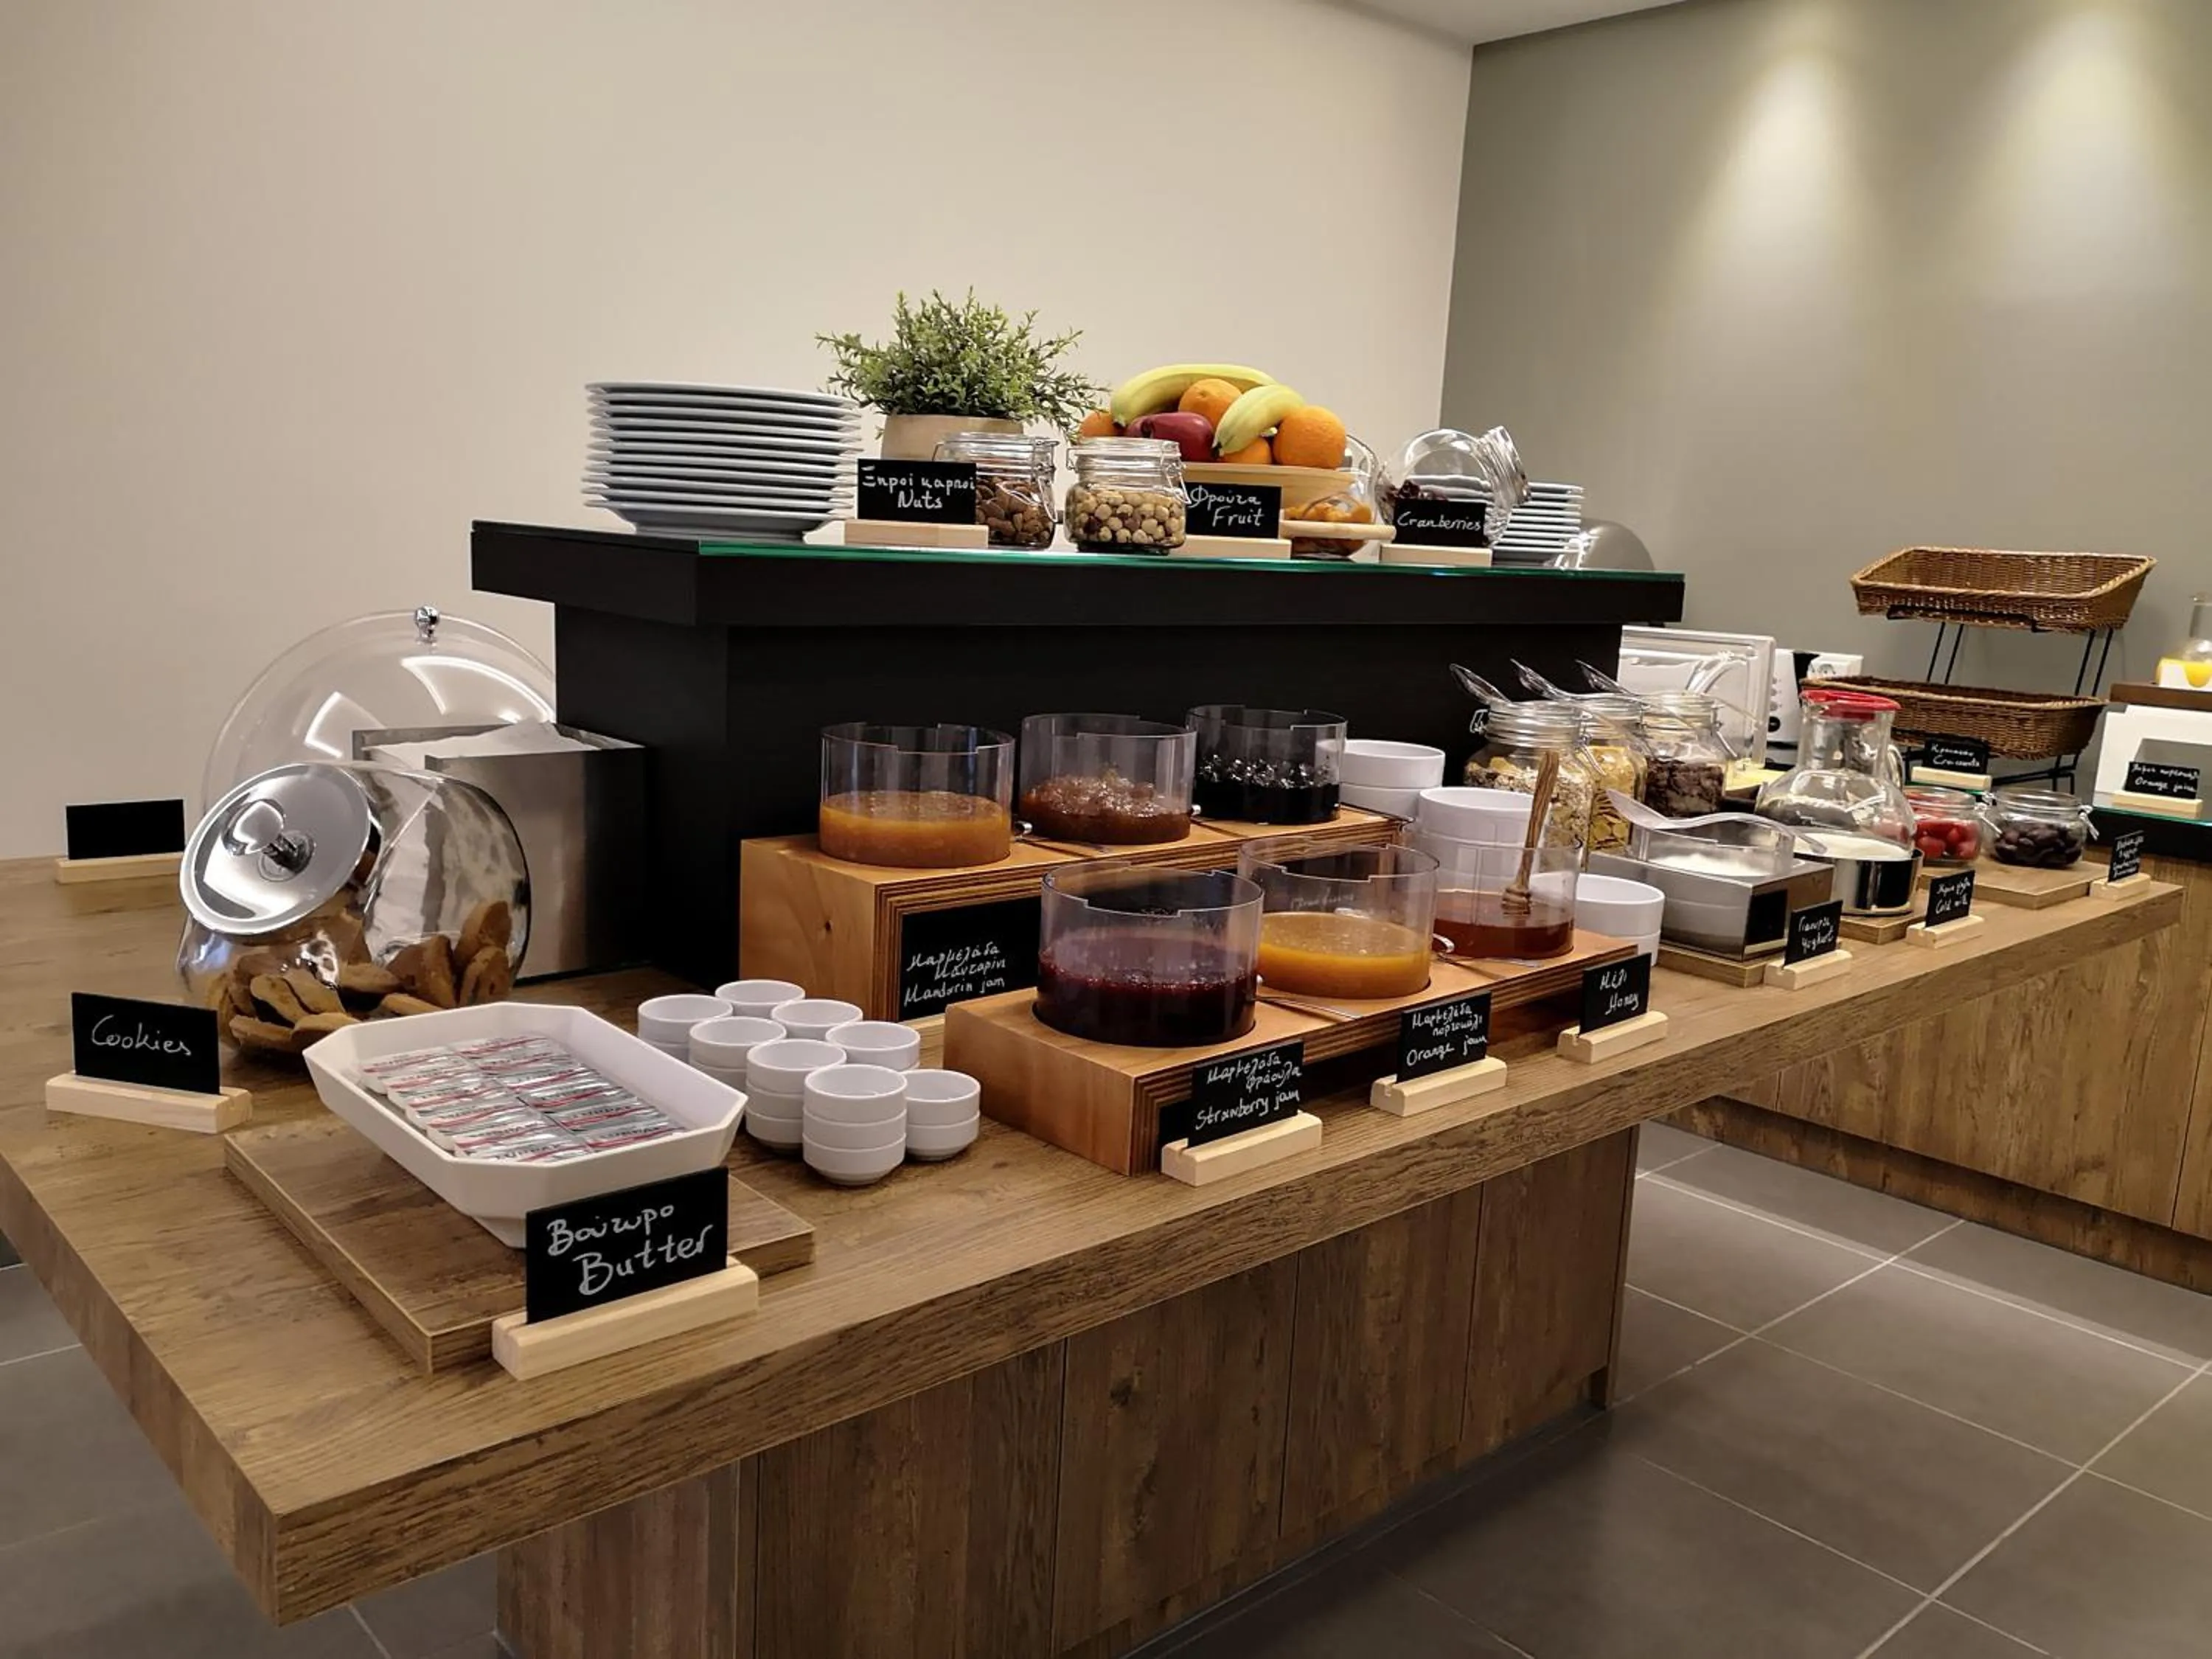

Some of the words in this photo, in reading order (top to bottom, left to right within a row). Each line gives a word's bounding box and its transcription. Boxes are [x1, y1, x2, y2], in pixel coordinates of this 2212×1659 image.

[897, 489, 943, 509] Nuts
[1211, 505, 1265, 527] Fruit
[1397, 510, 1482, 532] Cranberries
[903, 978, 973, 1007] Mandarin
[979, 976, 1005, 994] jam
[1604, 992, 1639, 1015] Honey
[91, 1015, 192, 1056] Cookies
[1406, 1042, 1455, 1066] Orange
[1462, 1034, 1488, 1057] jam
[1273, 1089, 1300, 1110] jam
[571, 1224, 714, 1295] Butter
